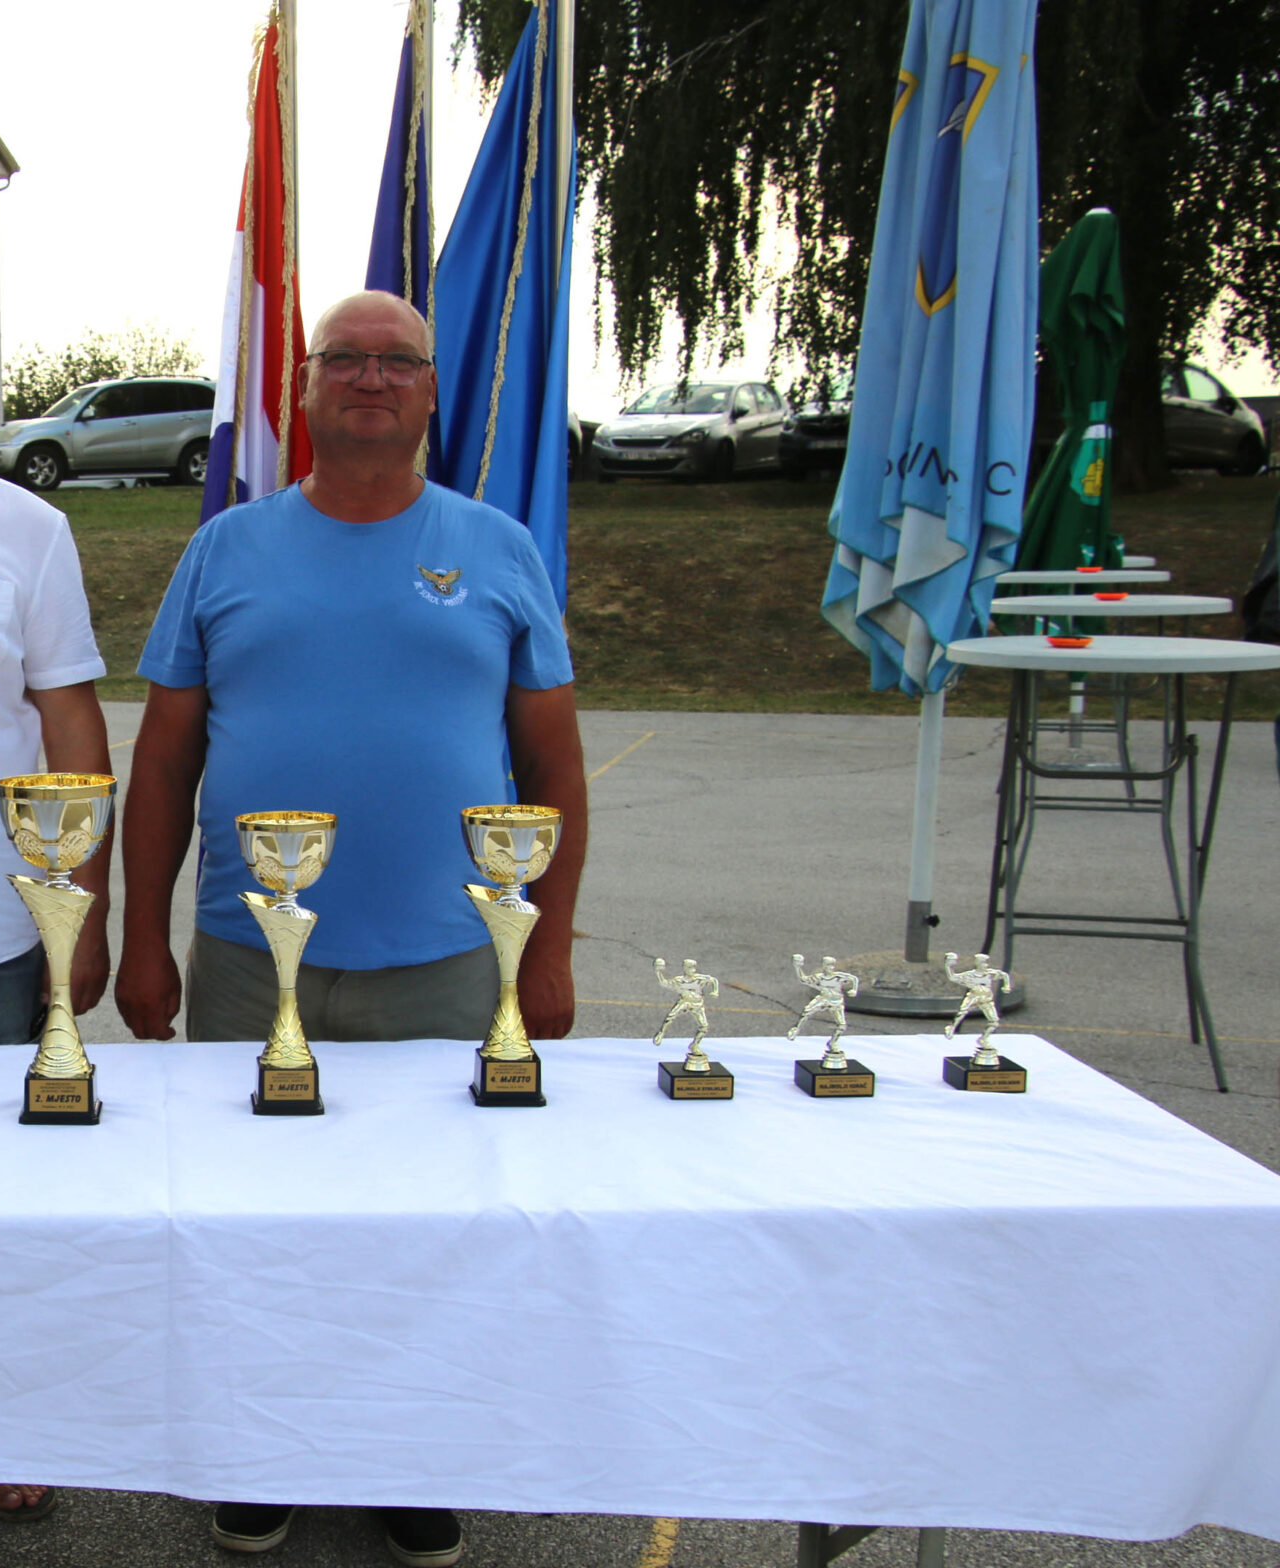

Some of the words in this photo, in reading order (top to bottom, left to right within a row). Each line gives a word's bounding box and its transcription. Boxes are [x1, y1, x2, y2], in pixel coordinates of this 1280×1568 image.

[500, 1075, 531, 1083] MJESTO
[278, 1083, 309, 1091] MJESTO
[45, 1094, 82, 1103] MJESTO
